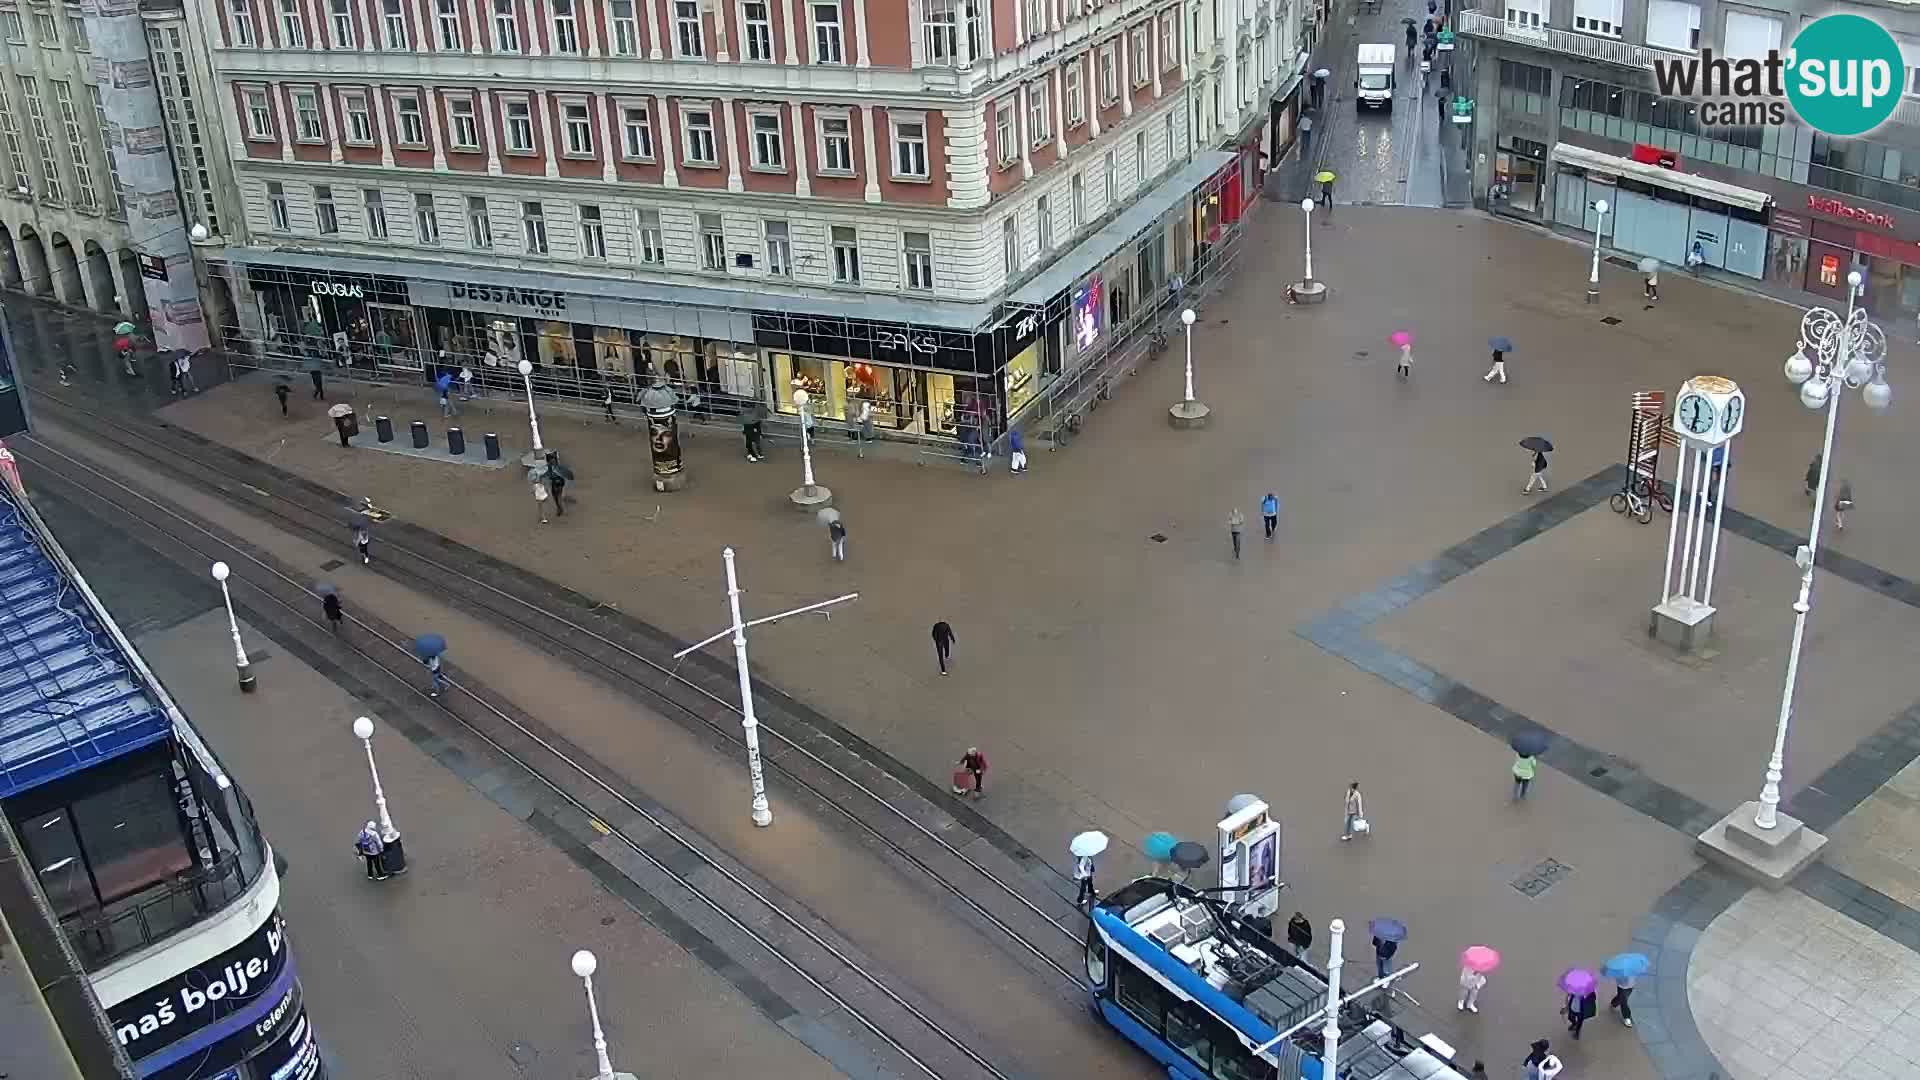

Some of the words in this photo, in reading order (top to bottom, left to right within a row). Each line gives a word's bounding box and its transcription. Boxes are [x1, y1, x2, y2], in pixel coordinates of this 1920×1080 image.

[311, 280, 364, 298] DOUGLAS
[452, 281, 566, 310] DESSANGE
[116, 997, 176, 1045] naš
[180, 956, 269, 1014] bolje,
